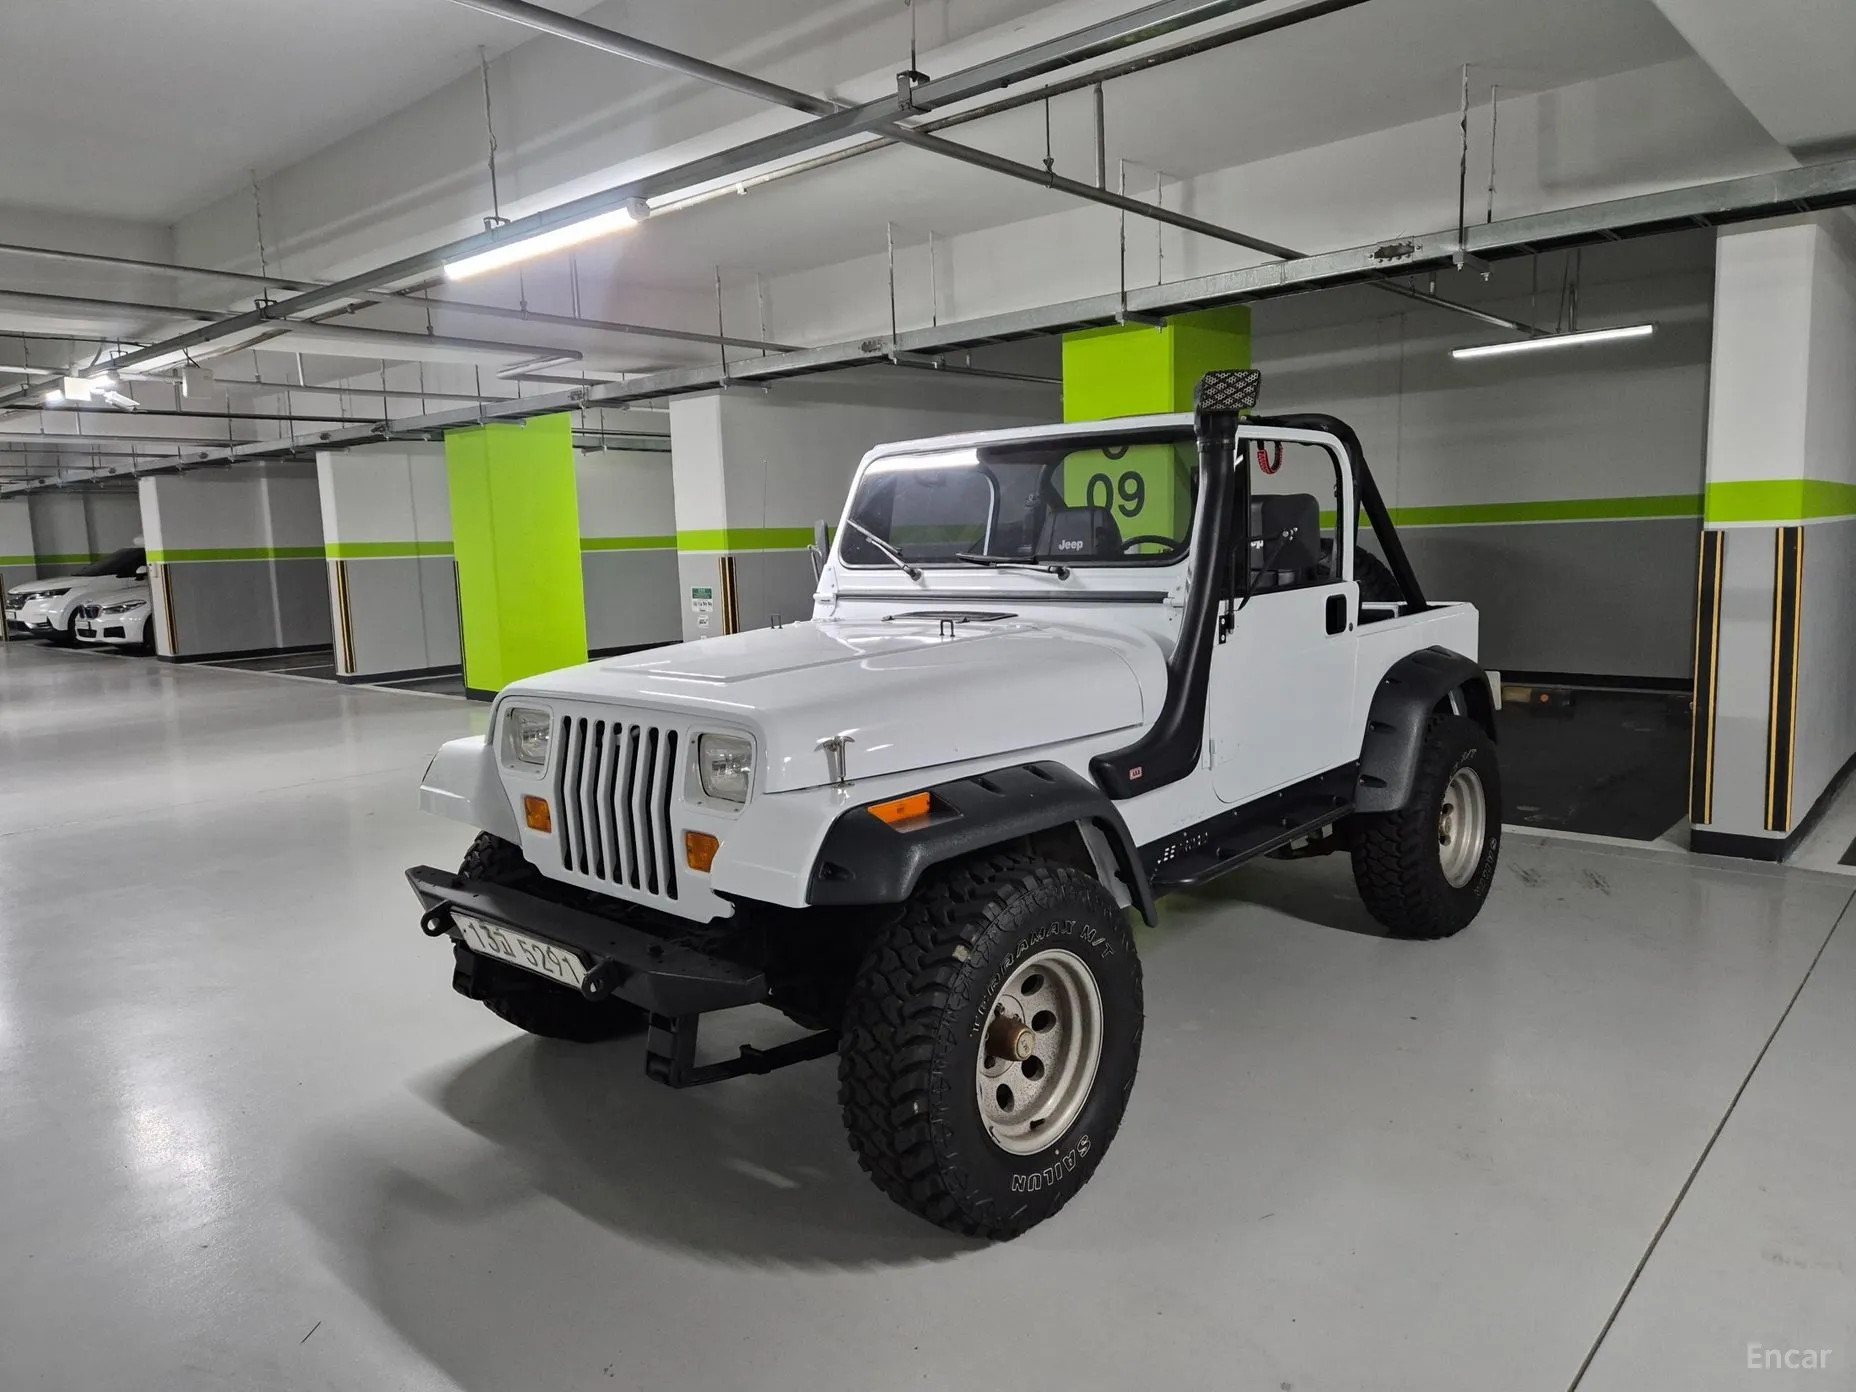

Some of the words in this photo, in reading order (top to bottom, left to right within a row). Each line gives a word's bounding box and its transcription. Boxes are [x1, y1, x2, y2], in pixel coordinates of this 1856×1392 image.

[1087, 471, 1145, 517] 09
[1058, 540, 1084, 551] Jeep
[517, 938, 580, 984] 5291
[1080, 925, 1114, 958] M/T
[1011, 1135, 1091, 1192] SAILUN
